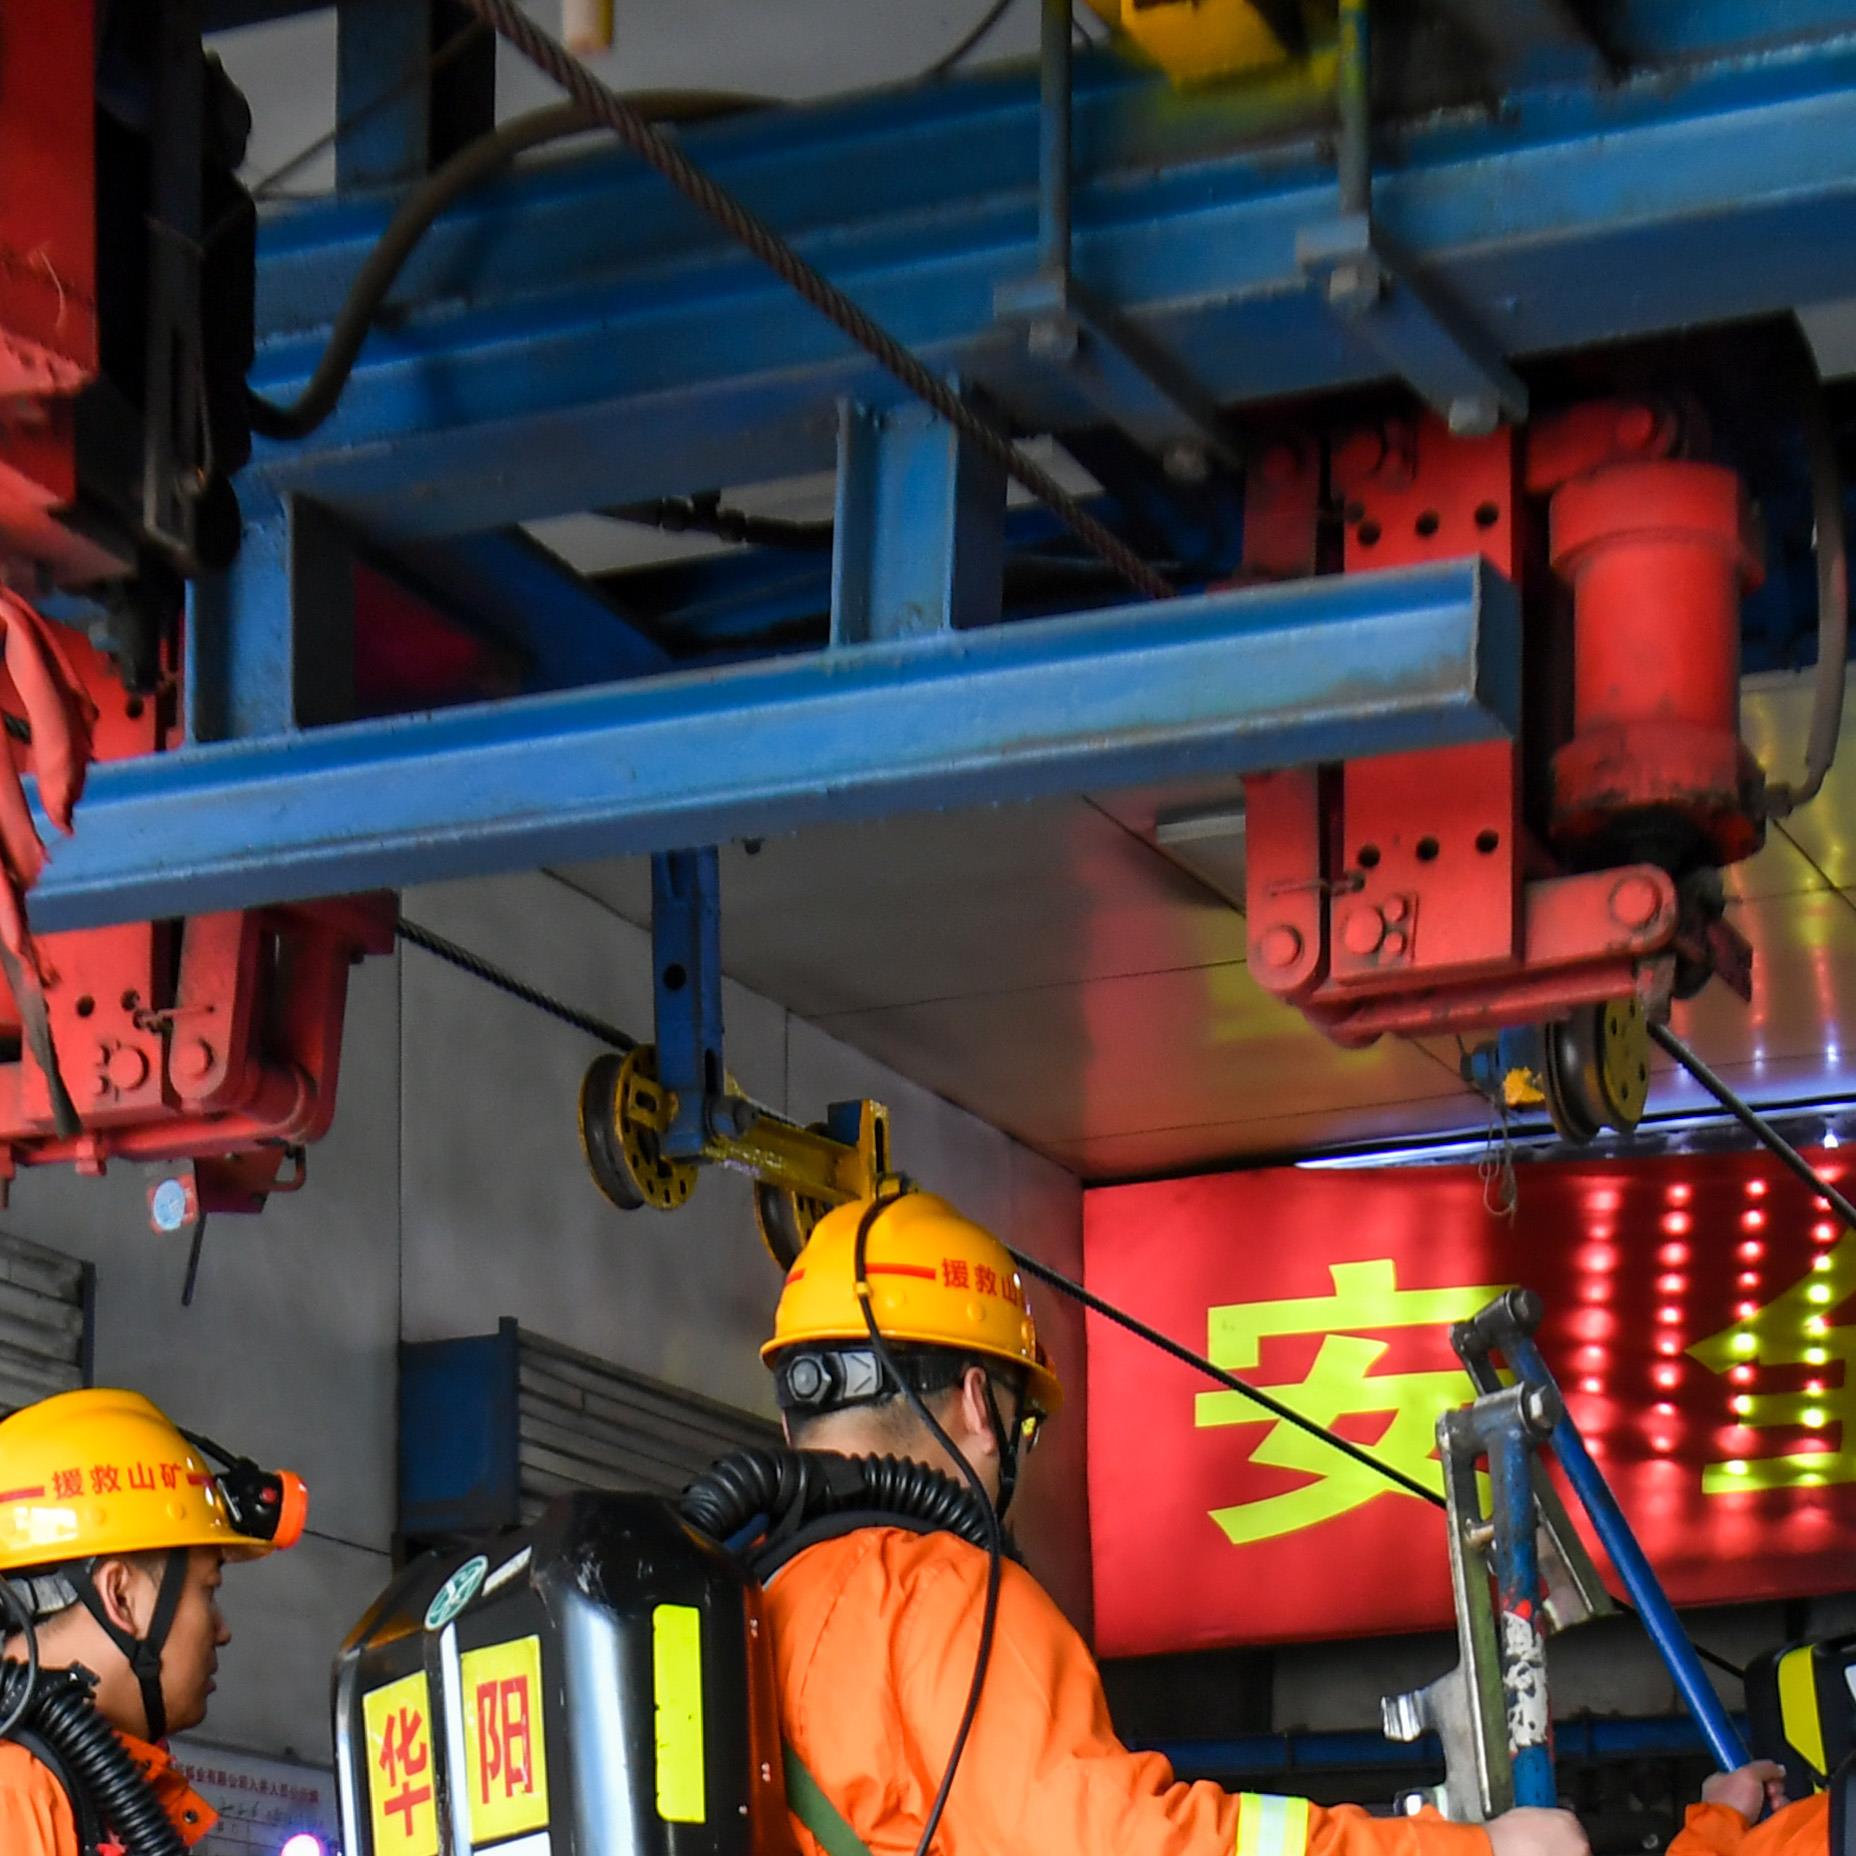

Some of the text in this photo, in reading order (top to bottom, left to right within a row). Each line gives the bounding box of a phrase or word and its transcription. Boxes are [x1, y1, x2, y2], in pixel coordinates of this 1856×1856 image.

[51, 1461, 183, 1500] 援救山矿
[378, 1674, 533, 1837] 华阳
